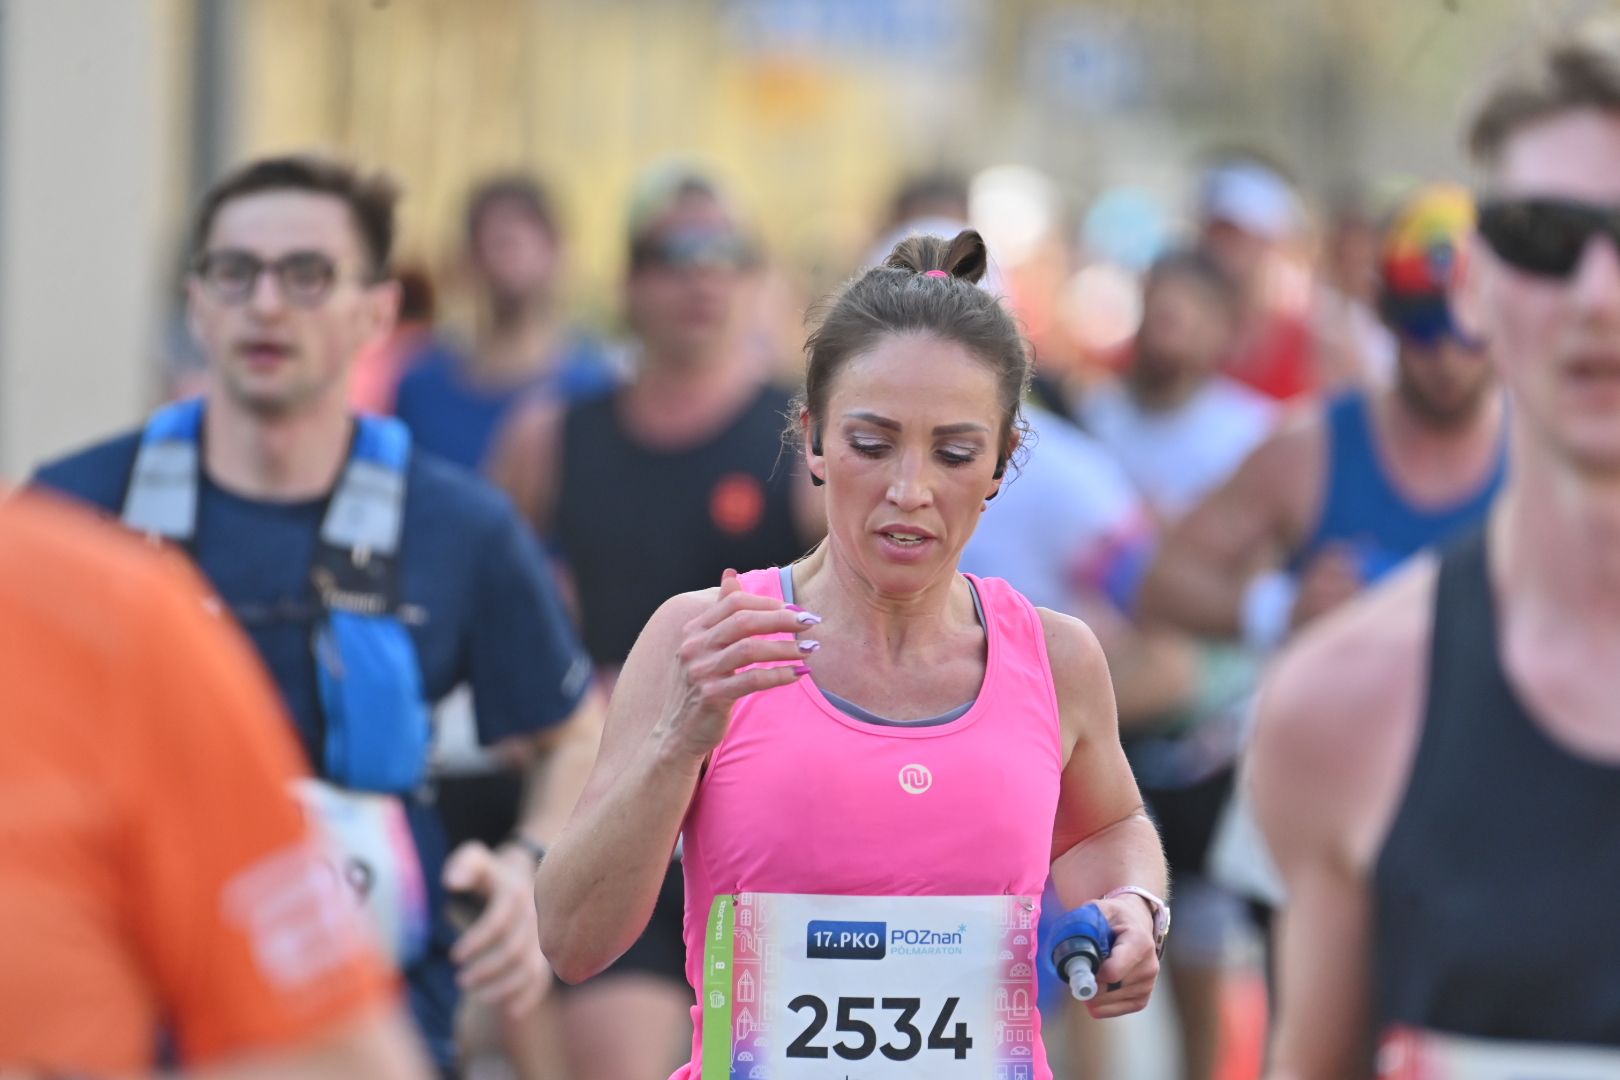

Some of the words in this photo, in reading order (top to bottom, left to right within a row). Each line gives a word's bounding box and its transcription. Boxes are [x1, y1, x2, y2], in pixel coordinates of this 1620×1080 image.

[715, 900, 727, 941] 13.04.2025
[890, 946, 962, 956] PÓŁMARATON
[716, 961, 726, 970] B
[786, 994, 973, 1062] 2534
